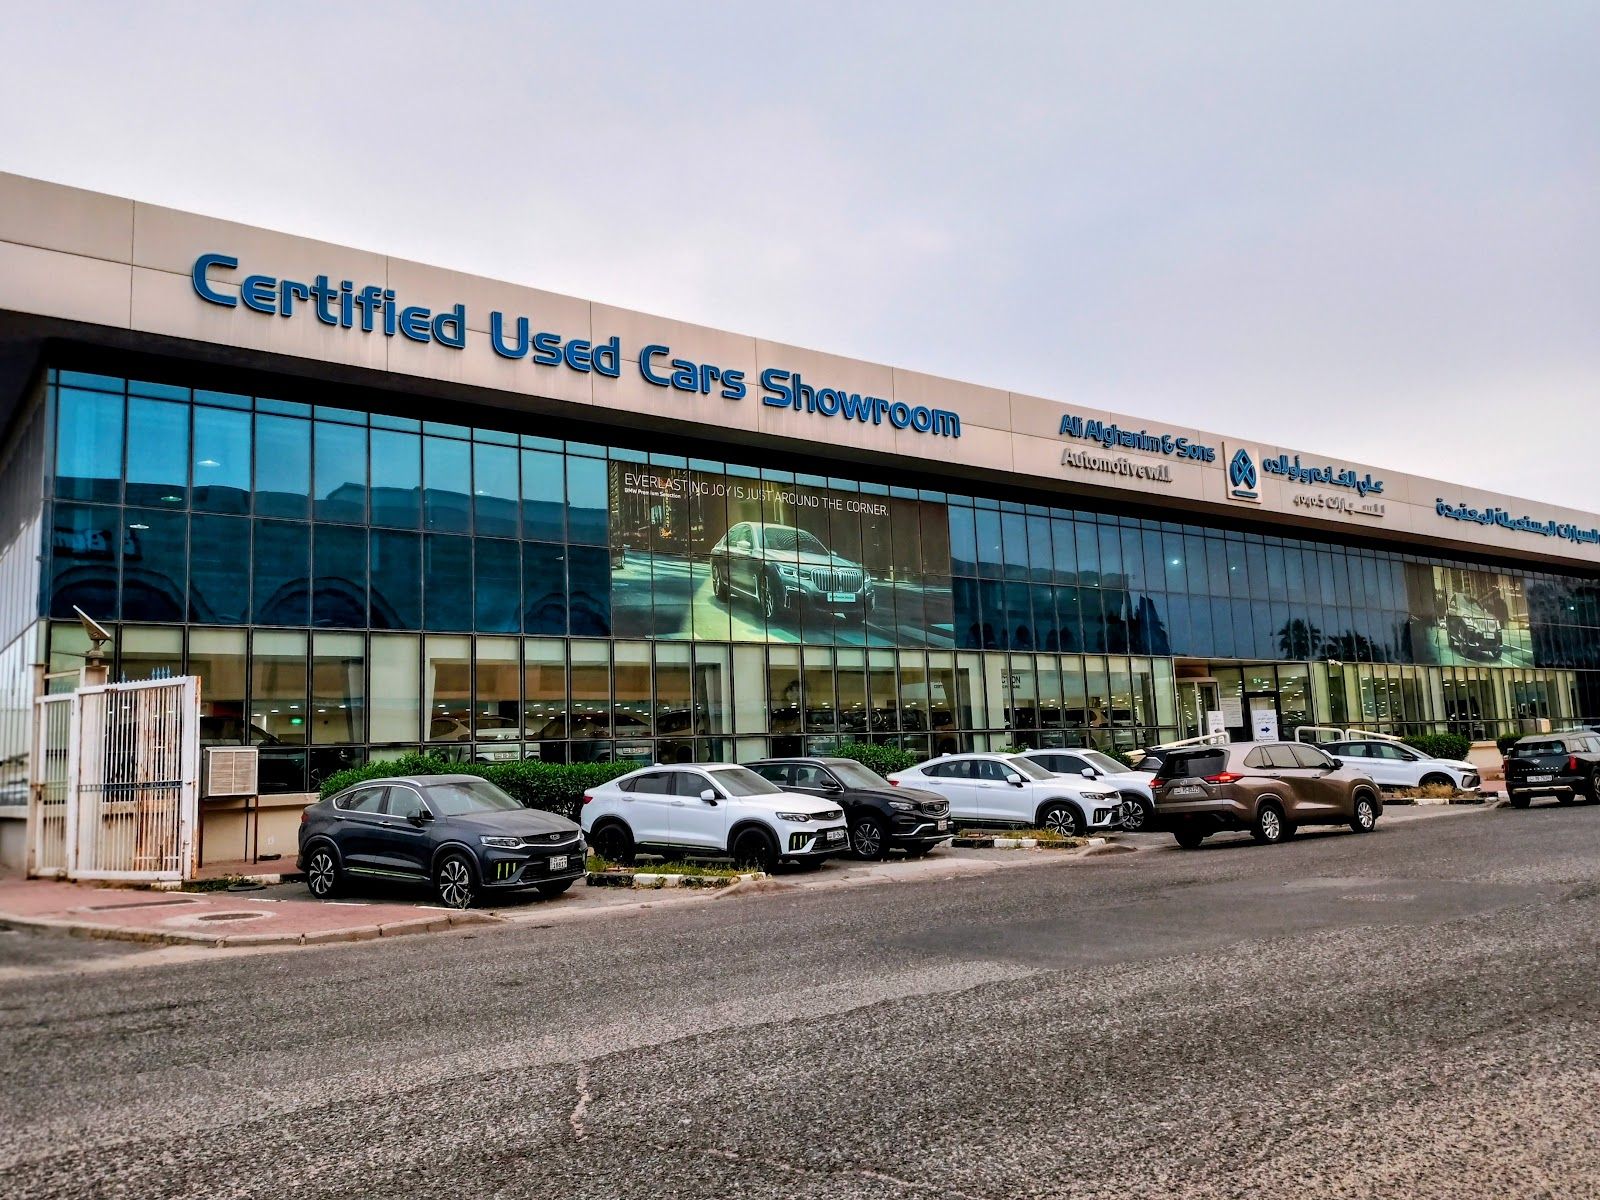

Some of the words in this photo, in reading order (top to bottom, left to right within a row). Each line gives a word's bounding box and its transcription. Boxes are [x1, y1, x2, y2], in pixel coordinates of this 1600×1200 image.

[192, 253, 466, 349] Certified
[490, 310, 620, 378] Used
[640, 343, 746, 400] Cars
[761, 368, 962, 439] Showroom
[1060, 414, 1083, 438] Ali
[1085, 419, 1160, 453] Alghanim
[1161, 434, 1176, 455] &
[1176, 437, 1216, 463] Sons
[1061, 448, 1146, 479] Automotive
[1309, 466, 1356, 488] الغانم
[625, 472, 709, 495] EVERLASTING
[711, 484, 732, 497] JOY
[734, 486, 744, 498] IS
[746, 488, 772, 502] JUST
[774, 491, 819, 508] AROUND
[822, 497, 843, 511] THE
[846, 500, 889, 517] CORNER.
[1357, 474, 1384, 497] علي
[1435, 497, 1494, 526] المعتمدة
